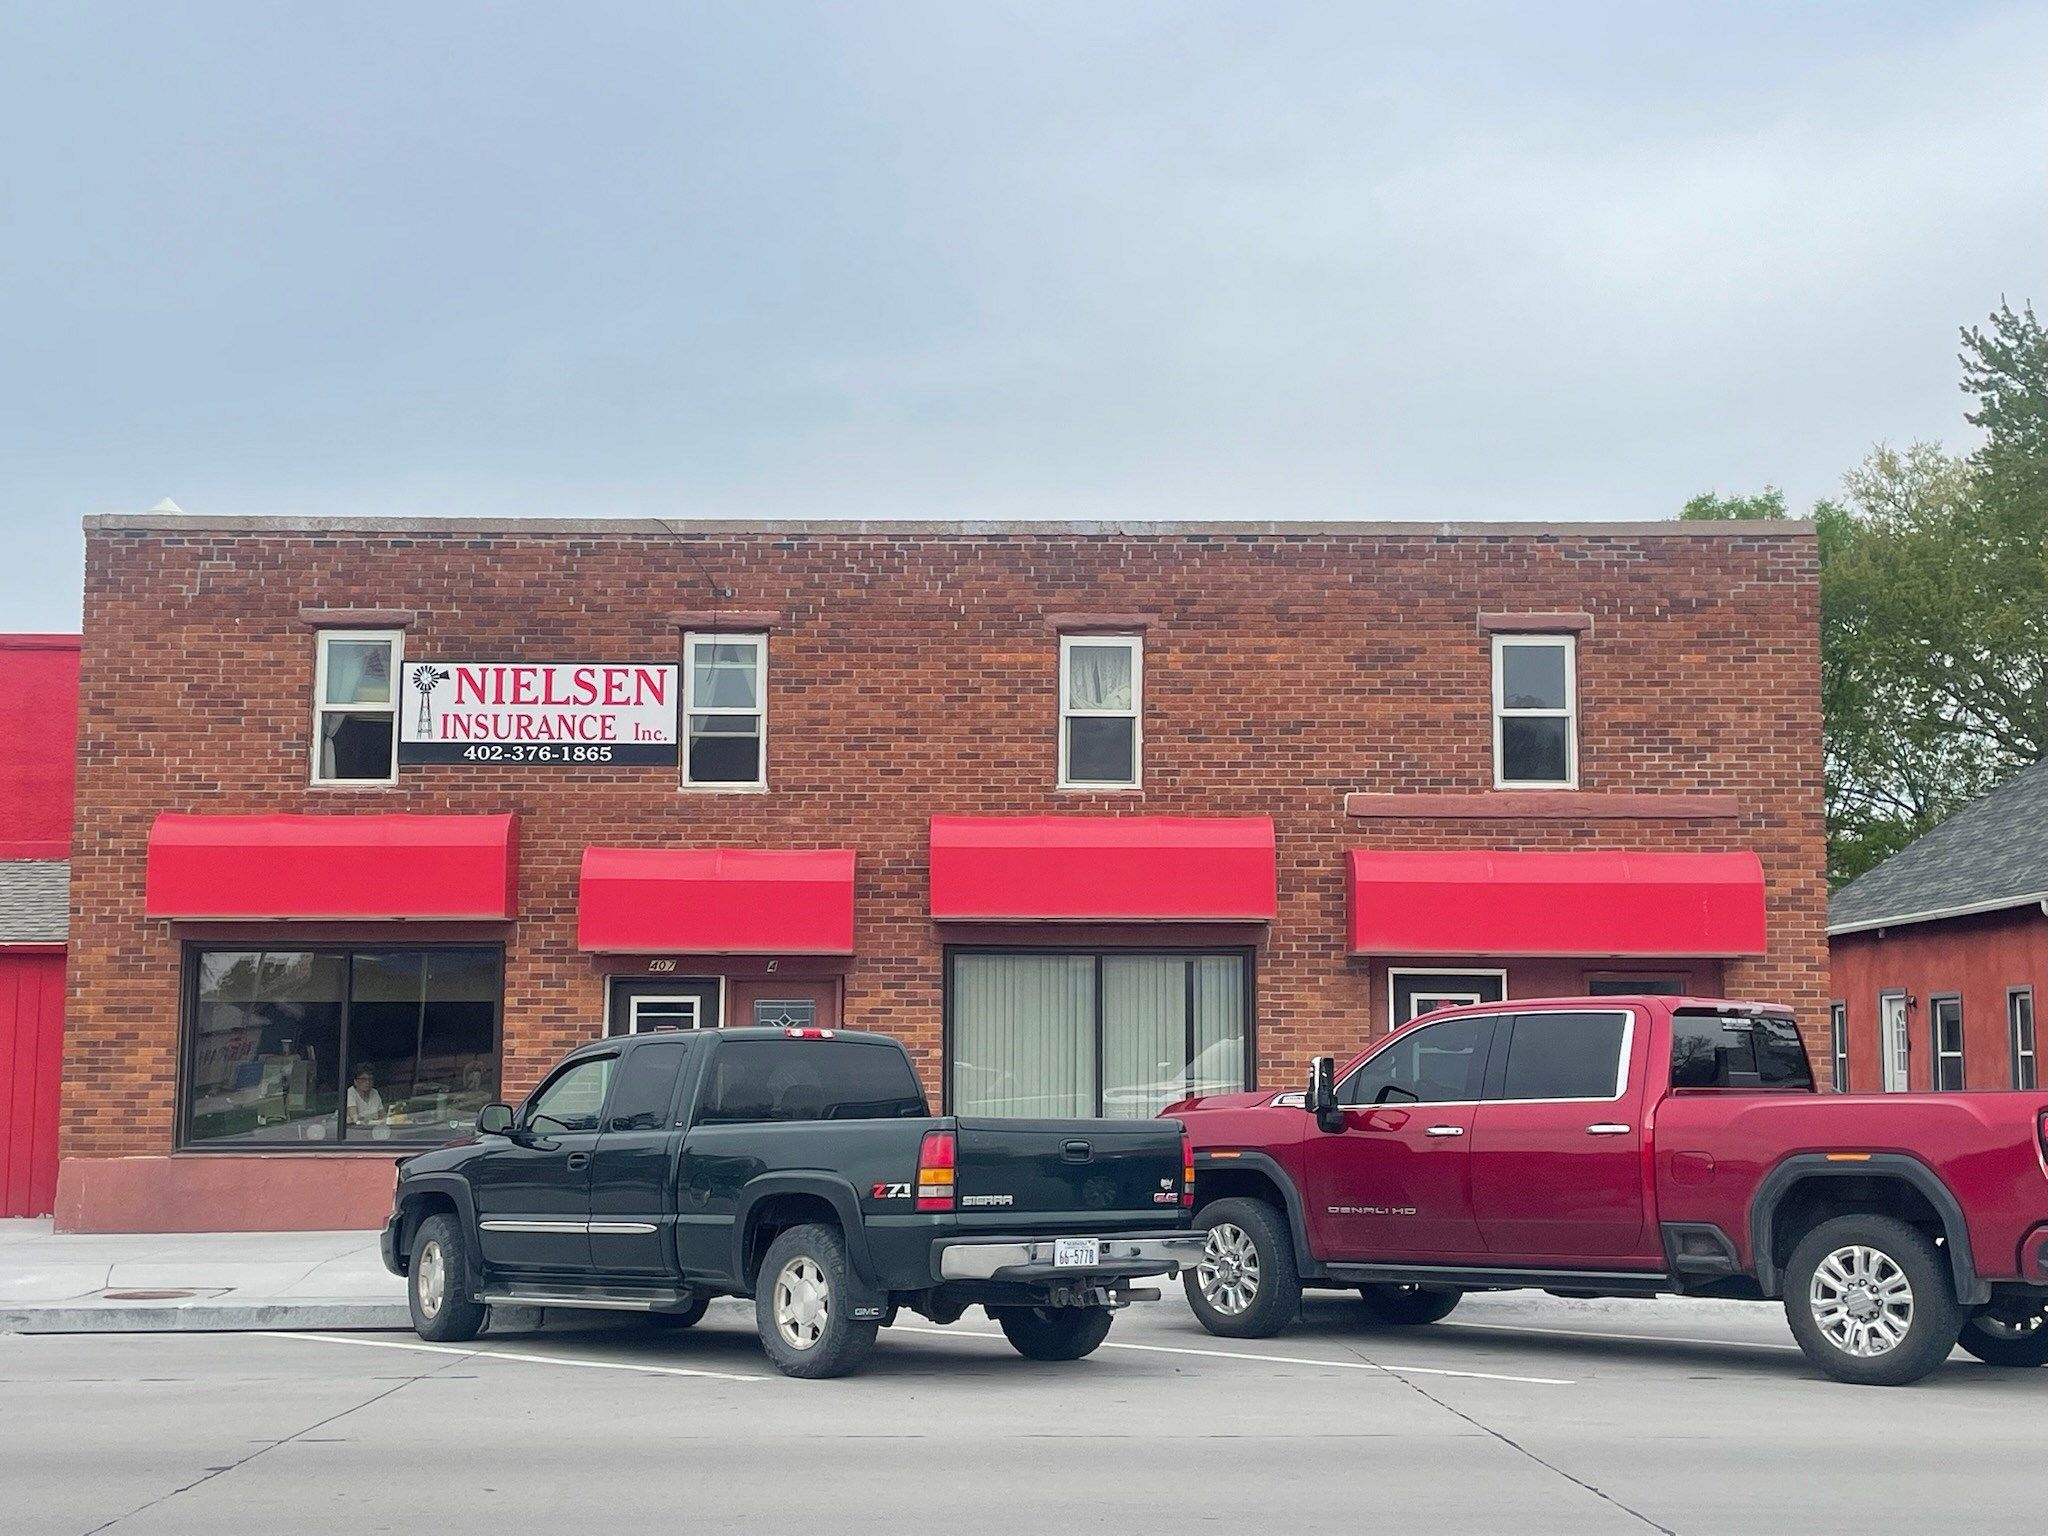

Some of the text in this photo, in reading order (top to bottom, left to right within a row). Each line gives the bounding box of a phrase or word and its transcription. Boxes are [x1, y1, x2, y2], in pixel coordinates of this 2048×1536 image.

[454, 667, 667, 706] NIELSEN
[440, 713, 668, 741] INSURANCE Inc.
[463, 745, 612, 761] 402-376-1865
[873, 1183, 911, 1199] Z71
[962, 1195, 1013, 1206] SIERRA
[1327, 1206, 1416, 1215] DENALI HD
[854, 1307, 879, 1316] GMC
